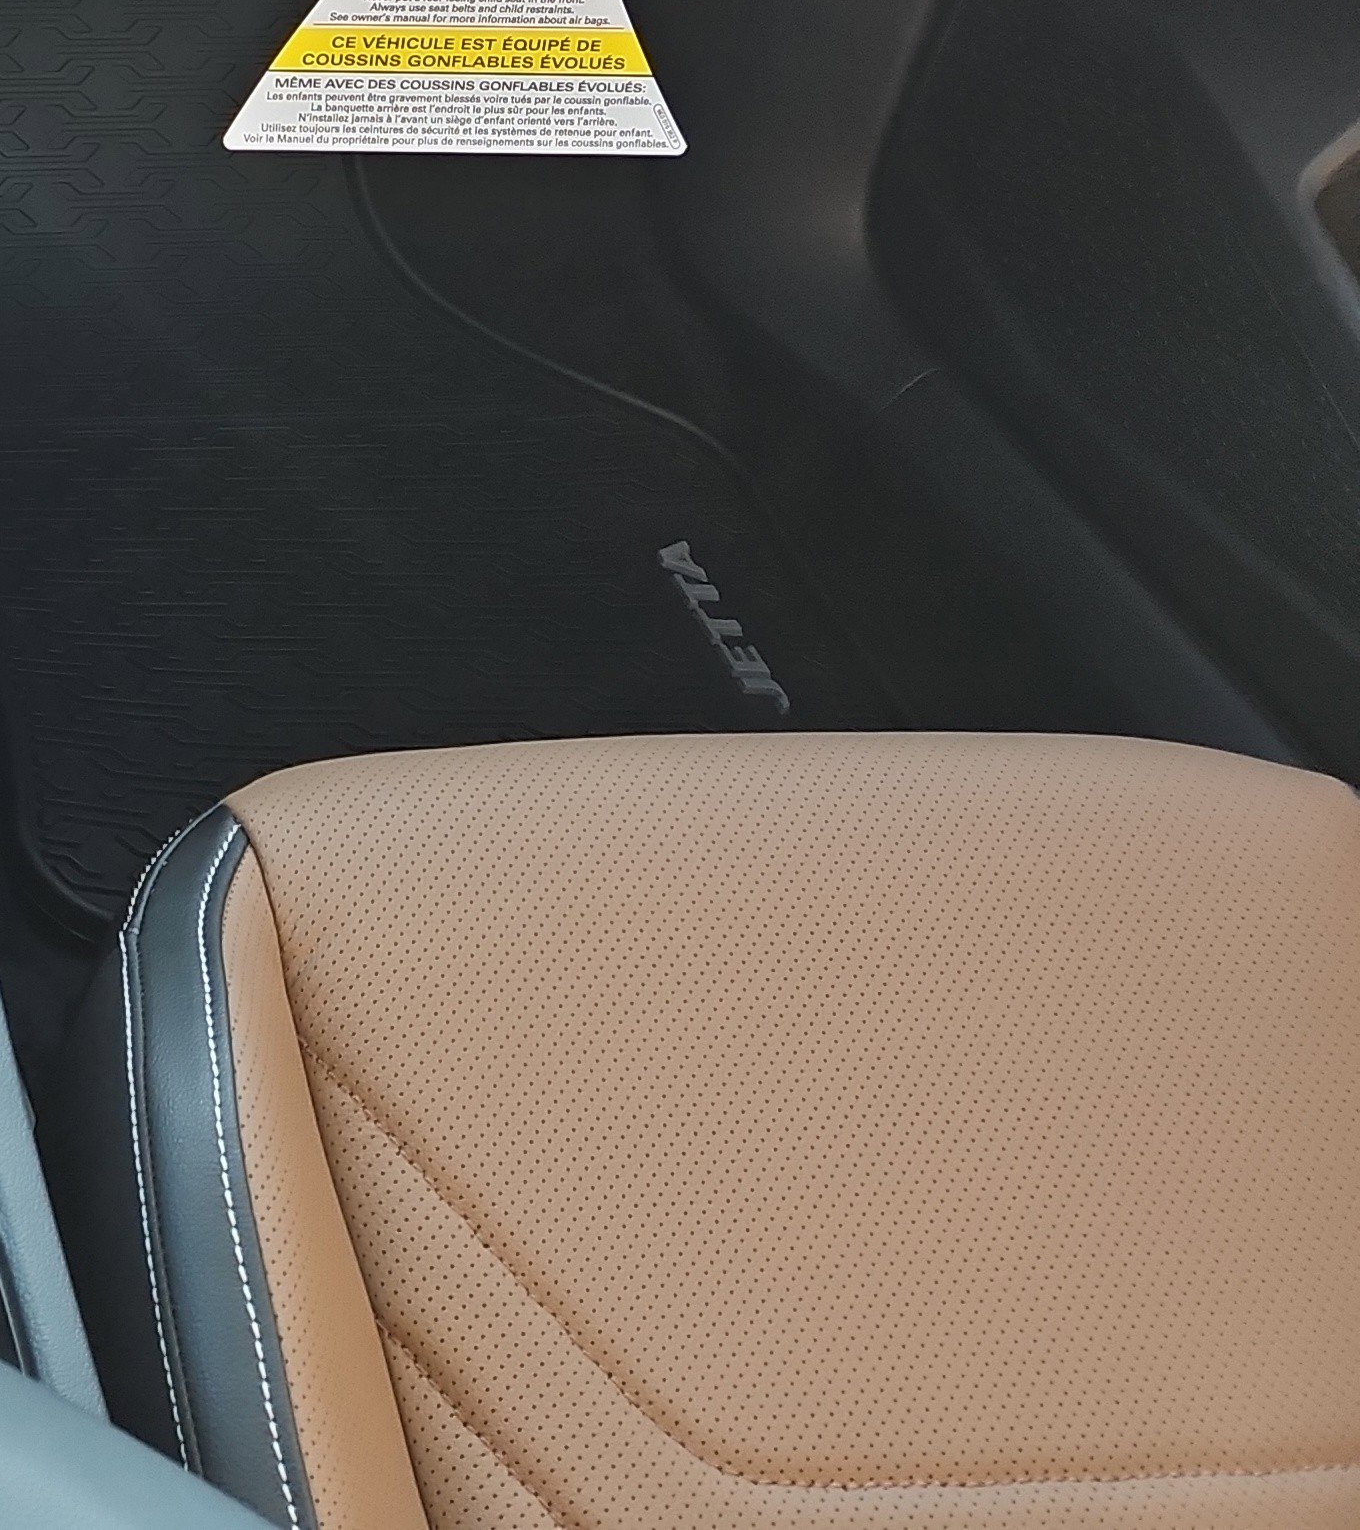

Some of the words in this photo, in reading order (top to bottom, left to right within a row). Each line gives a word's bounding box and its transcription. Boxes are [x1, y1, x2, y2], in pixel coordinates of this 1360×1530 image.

[369, 2, 406, 14] Always
[408, 4, 426, 12] use
[427, 4, 449, 14] seat
[451, 3, 476, 12] belts
[477, 4, 497, 14] and
[498, 3, 524, 13] child
[525, 4, 574, 14] restraints.
[329, 12, 348, 21] See
[392, 13, 430, 22] manual
[432, 13, 447, 22] for
[448, 15, 475, 23] more
[477, 14, 535, 23] information
[537, 15, 567, 24] about
[568, 15, 582, 24] air
[583, 15, 610, 26] bags.
[331, 35, 356, 48] CE
[362, 35, 454, 49] VÉHICULE
[460, 37, 497, 50] EST
[501, 36, 570, 51] ÉQUIPÉ
[576, 39, 601, 52] DE
[302, 53, 400, 66] COUSSINS
[407, 54, 533, 68] GONFLABLES
[539, 53, 625, 69] ÉVOLUÉS
[275, 76, 321, 88] MÊME
[324, 78, 364, 89] AVEC
[367, 78, 396, 89] DES
[399, 79, 475, 90] COUSSINS
[478, 80, 574, 92] GONFLABLES
[577, 79, 646, 92] ÉVOLUÉS:
[658, 540, 790, 714] JETTA
